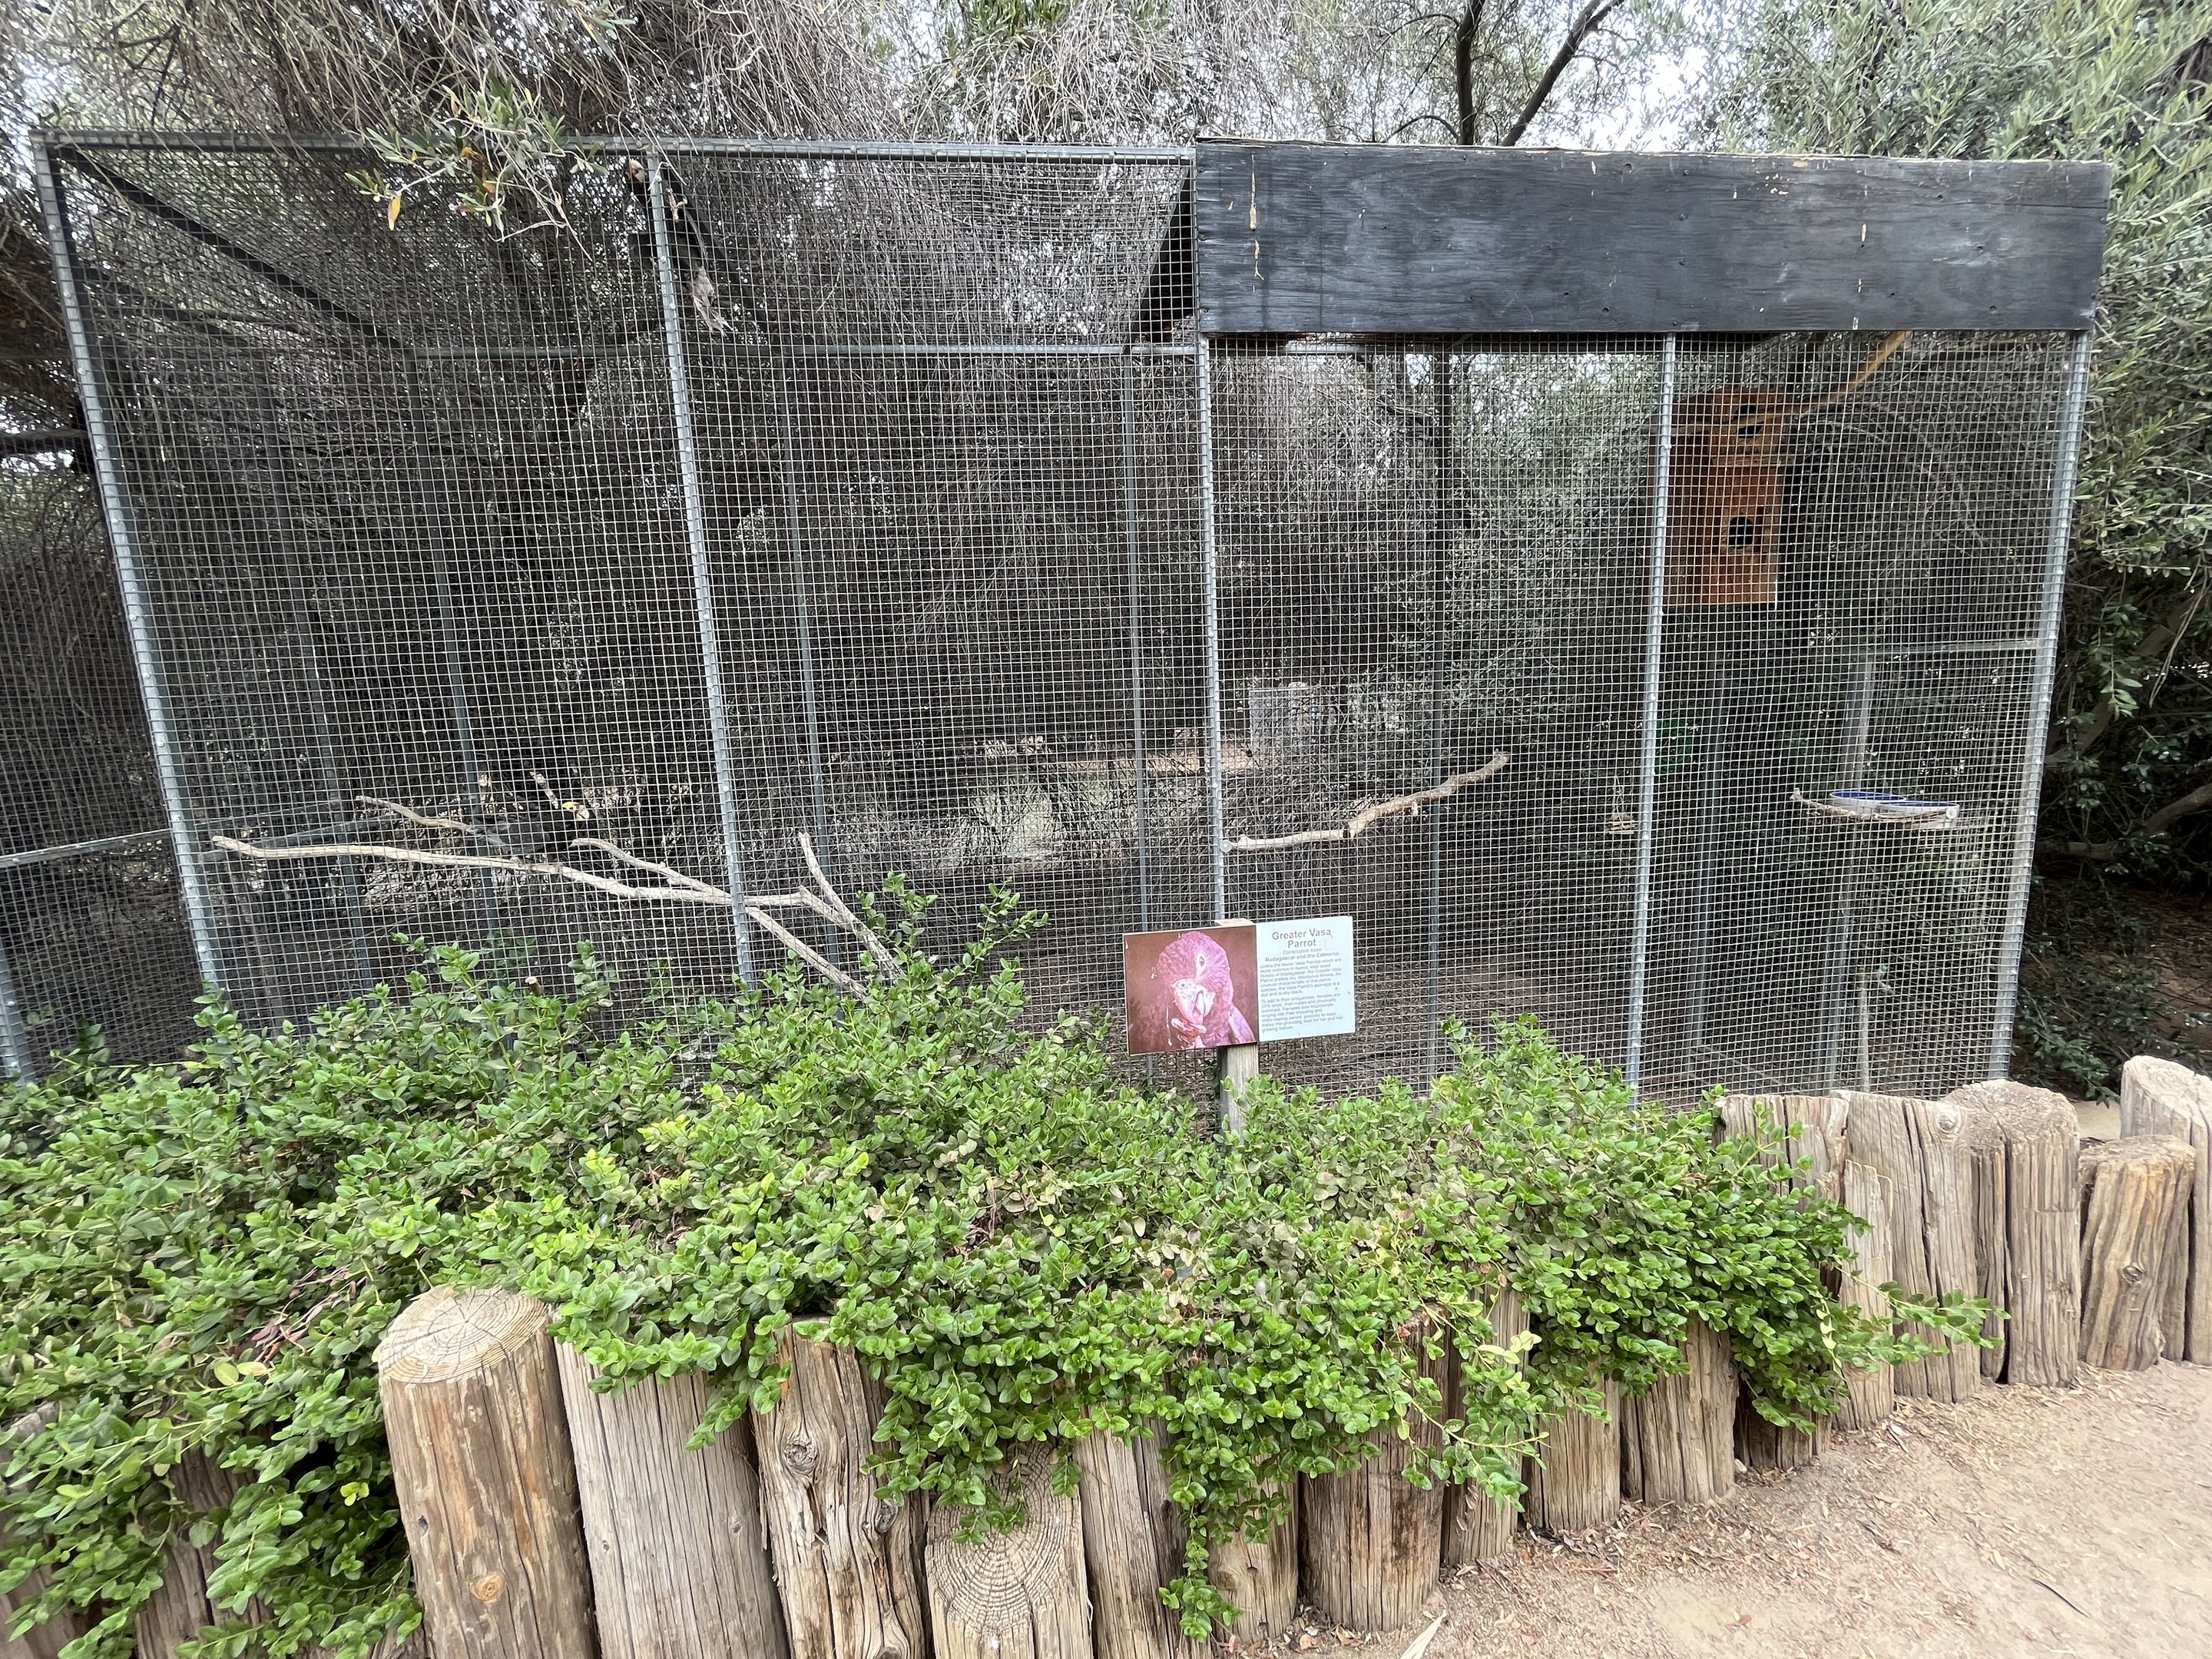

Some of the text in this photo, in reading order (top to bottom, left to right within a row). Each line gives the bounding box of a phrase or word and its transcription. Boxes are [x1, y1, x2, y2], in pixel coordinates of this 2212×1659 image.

[1272, 929, 1331, 940] Greater Vasa
[1288, 939, 1316, 948] Parrot
